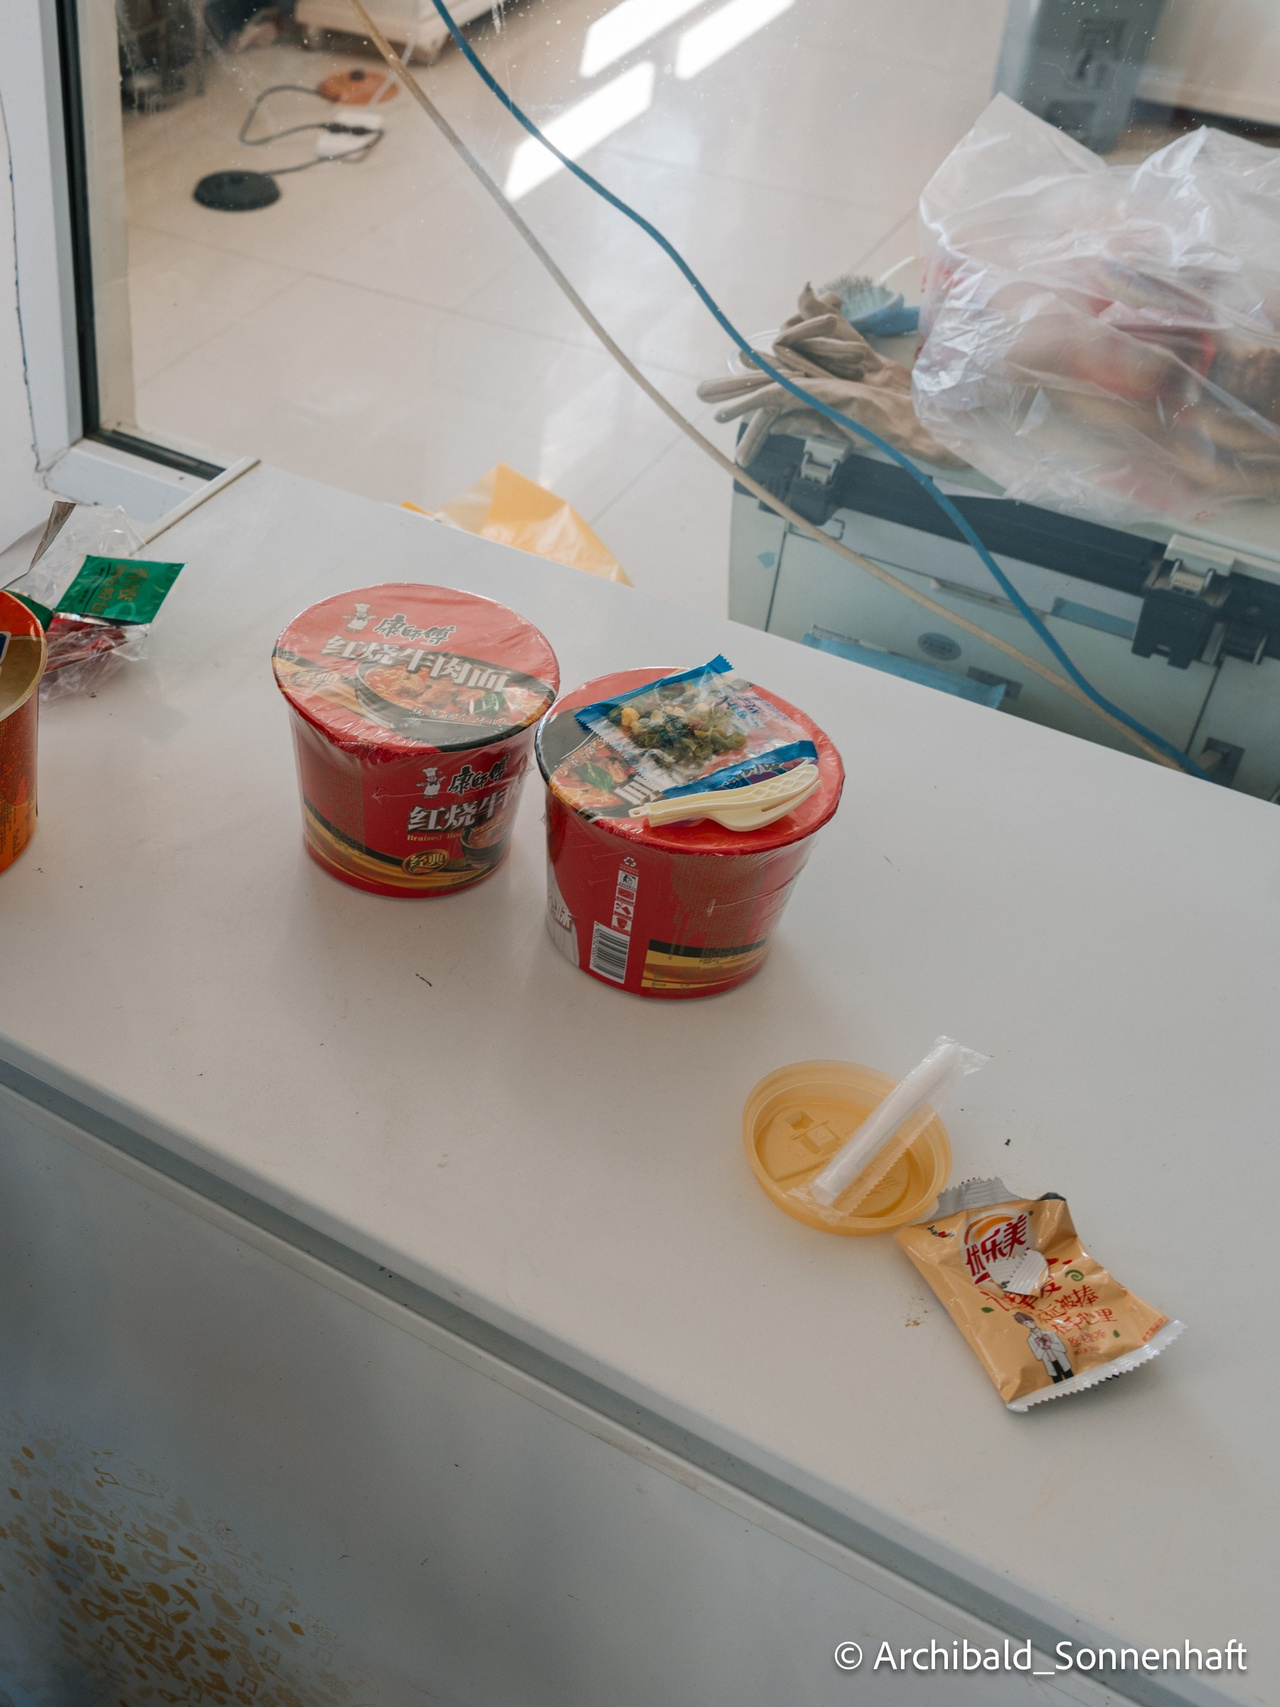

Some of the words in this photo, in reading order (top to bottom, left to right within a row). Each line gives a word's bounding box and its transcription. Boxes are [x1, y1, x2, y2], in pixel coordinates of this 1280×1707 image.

[322, 634, 511, 692] 红烧牛肉面
[409, 852, 445, 868] 经典
[965, 1214, 1027, 1278] 优乐美
